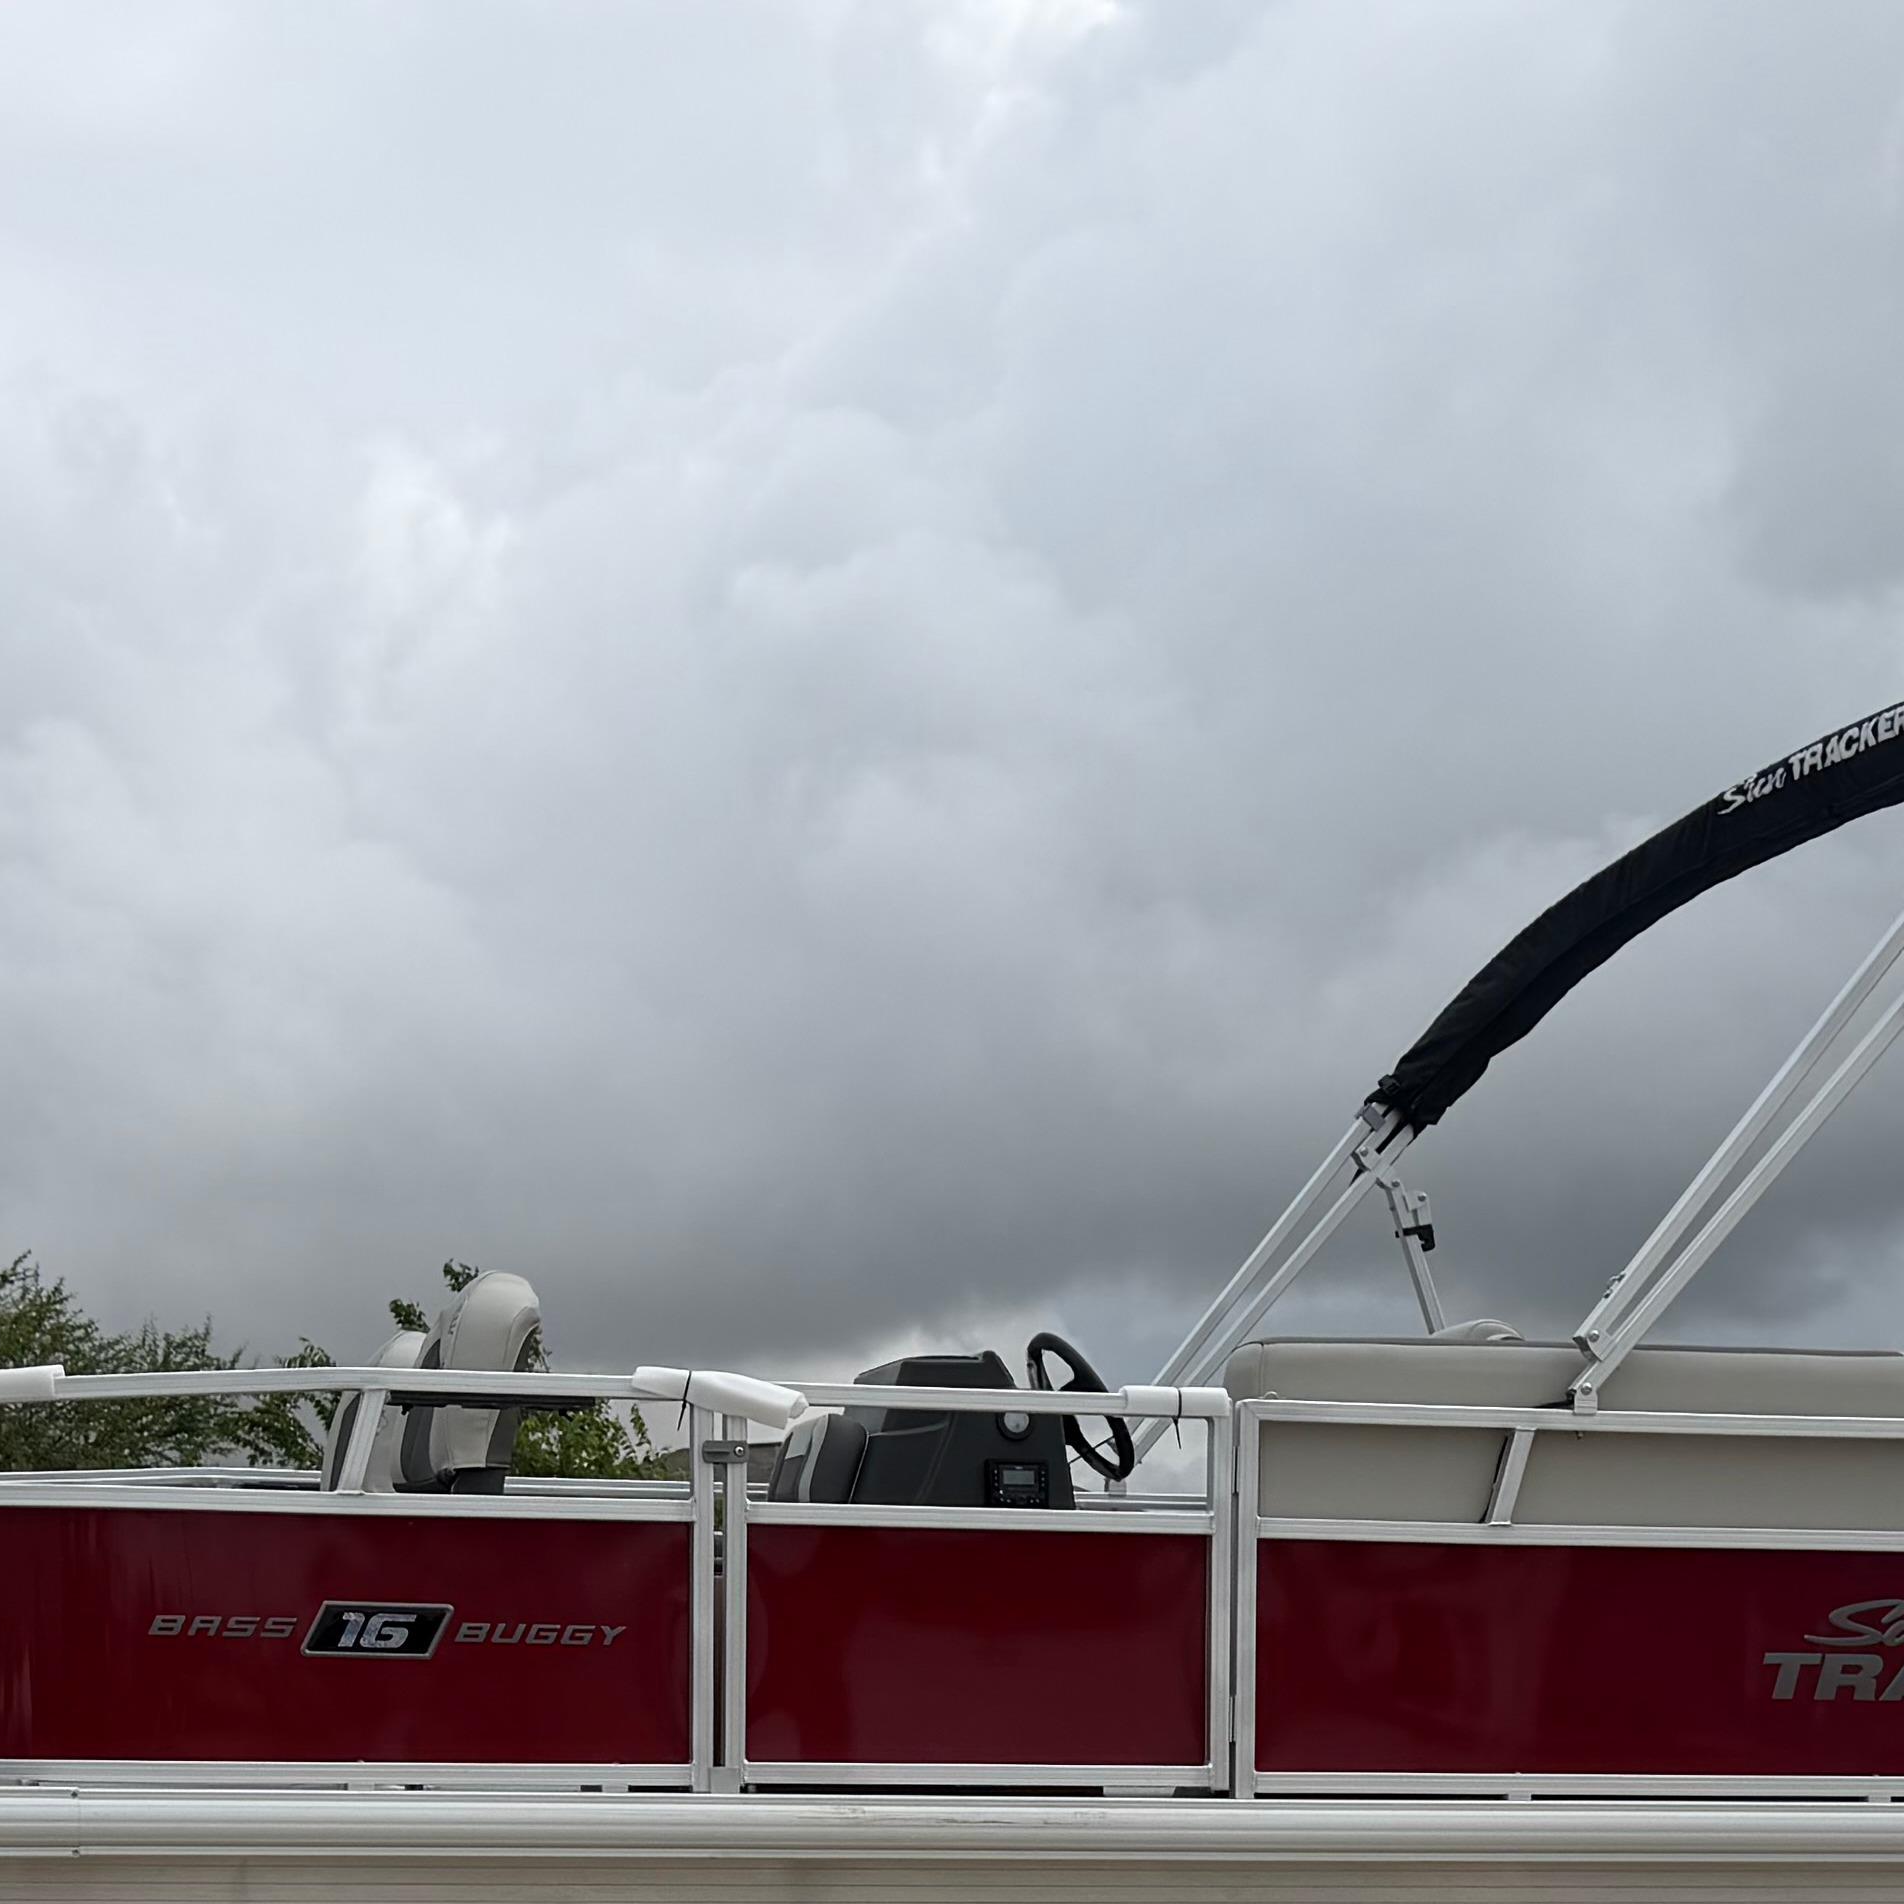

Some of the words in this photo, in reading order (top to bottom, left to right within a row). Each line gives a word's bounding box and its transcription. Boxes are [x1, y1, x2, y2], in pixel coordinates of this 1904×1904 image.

[1717, 768, 1787, 815] Sun
[148, 1614, 298, 1637] BASS
[338, 1612, 417, 1648] 16
[454, 1622, 626, 1646] BUGGY
